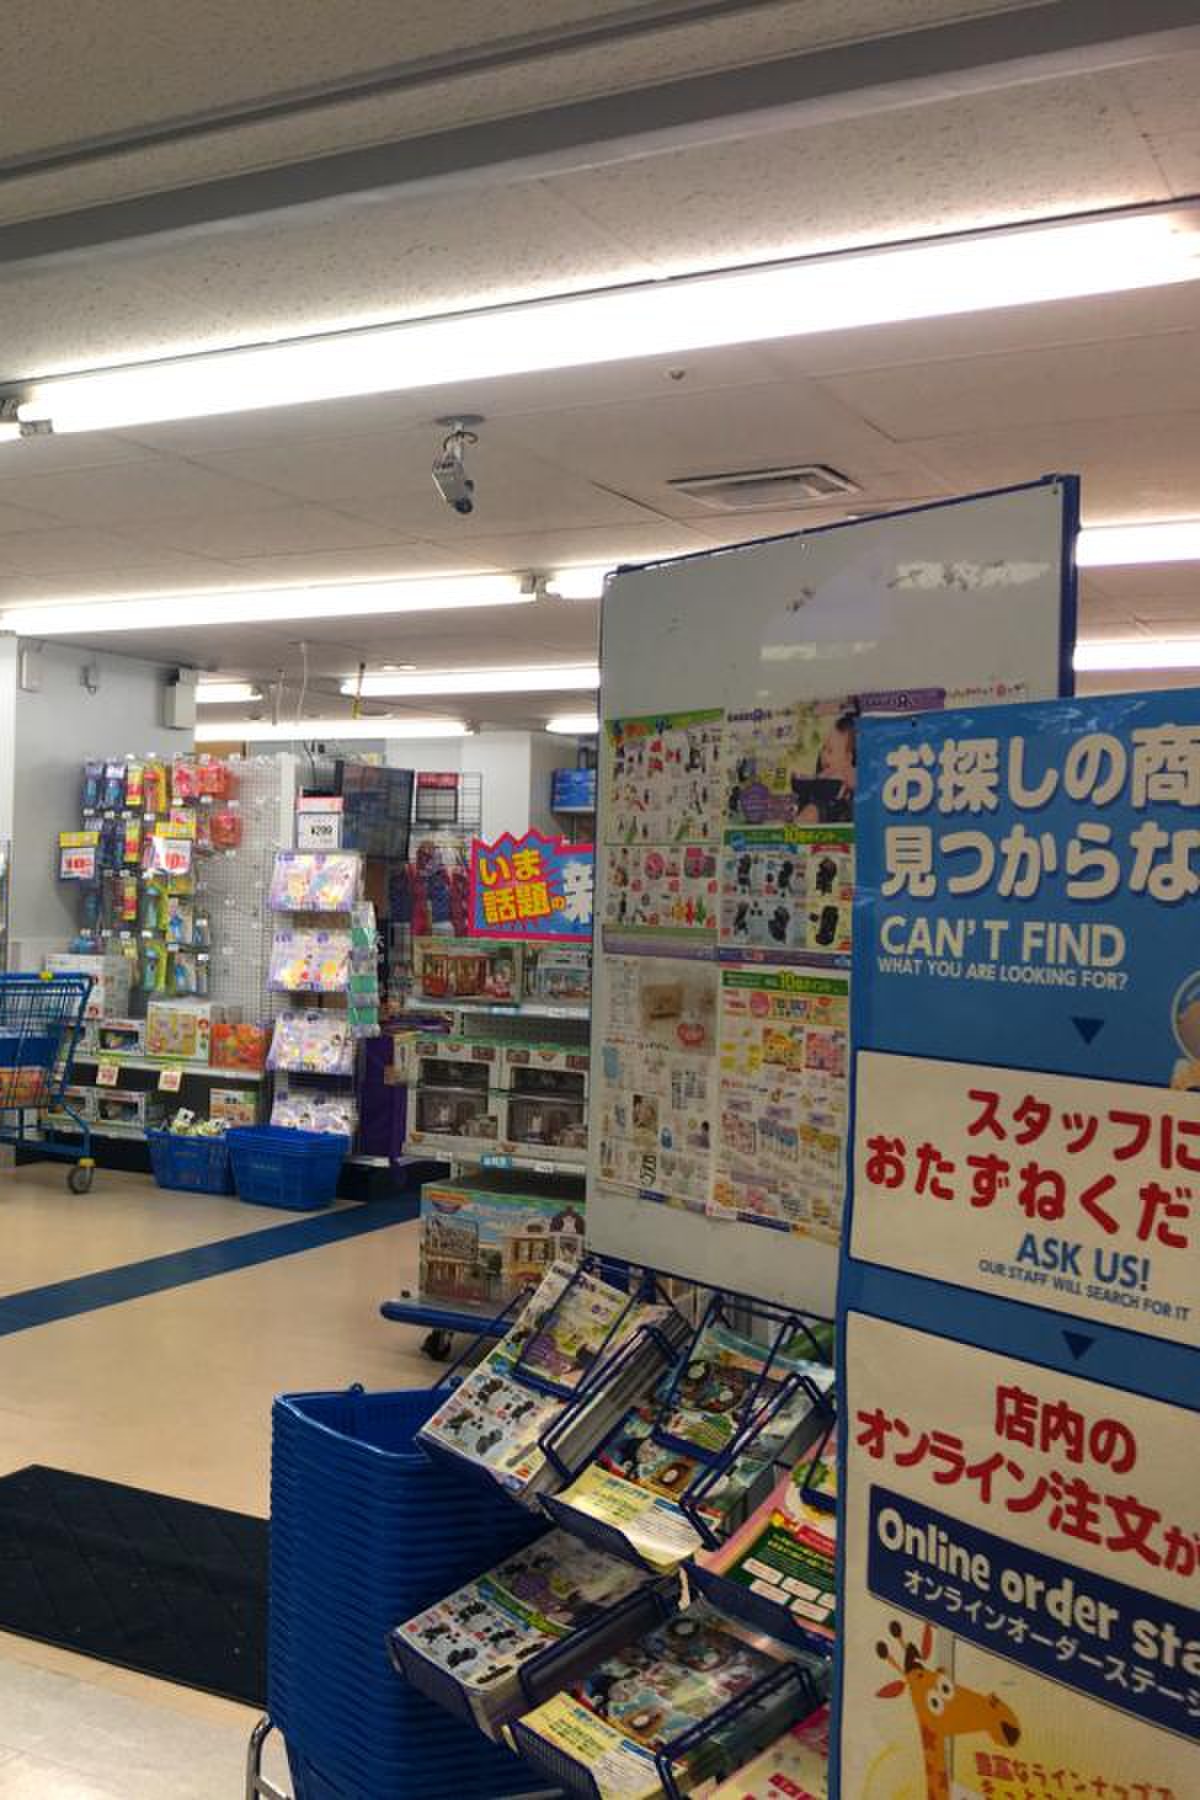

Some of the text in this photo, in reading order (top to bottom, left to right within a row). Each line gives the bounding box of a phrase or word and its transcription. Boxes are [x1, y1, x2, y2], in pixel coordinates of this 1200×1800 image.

[882, 725, 1200, 812] お探しの商
[479, 849, 542, 885] いま
[881, 821, 1200, 902] 見つからな
[483, 881, 567, 924] 話題の
[879, 915, 1127, 968] CAN'T FIND
[878, 956, 1128, 991] WHAT YOU ARE LOOKING FOR?
[967, 1089, 1200, 1172] スタッフに
[865, 1135, 1192, 1249] おたずねくだ
[978, 1259, 1191, 1322] OUR STAFF WILL SEARCH FOR IT
[1015, 1233, 1152, 1292] ASK US!
[995, 1385, 1137, 1474] 店内の
[856, 1408, 1200, 1577] オンライン注文が
[878, 1507, 991, 1592] Online
[1000, 1568, 1120, 1641] order
